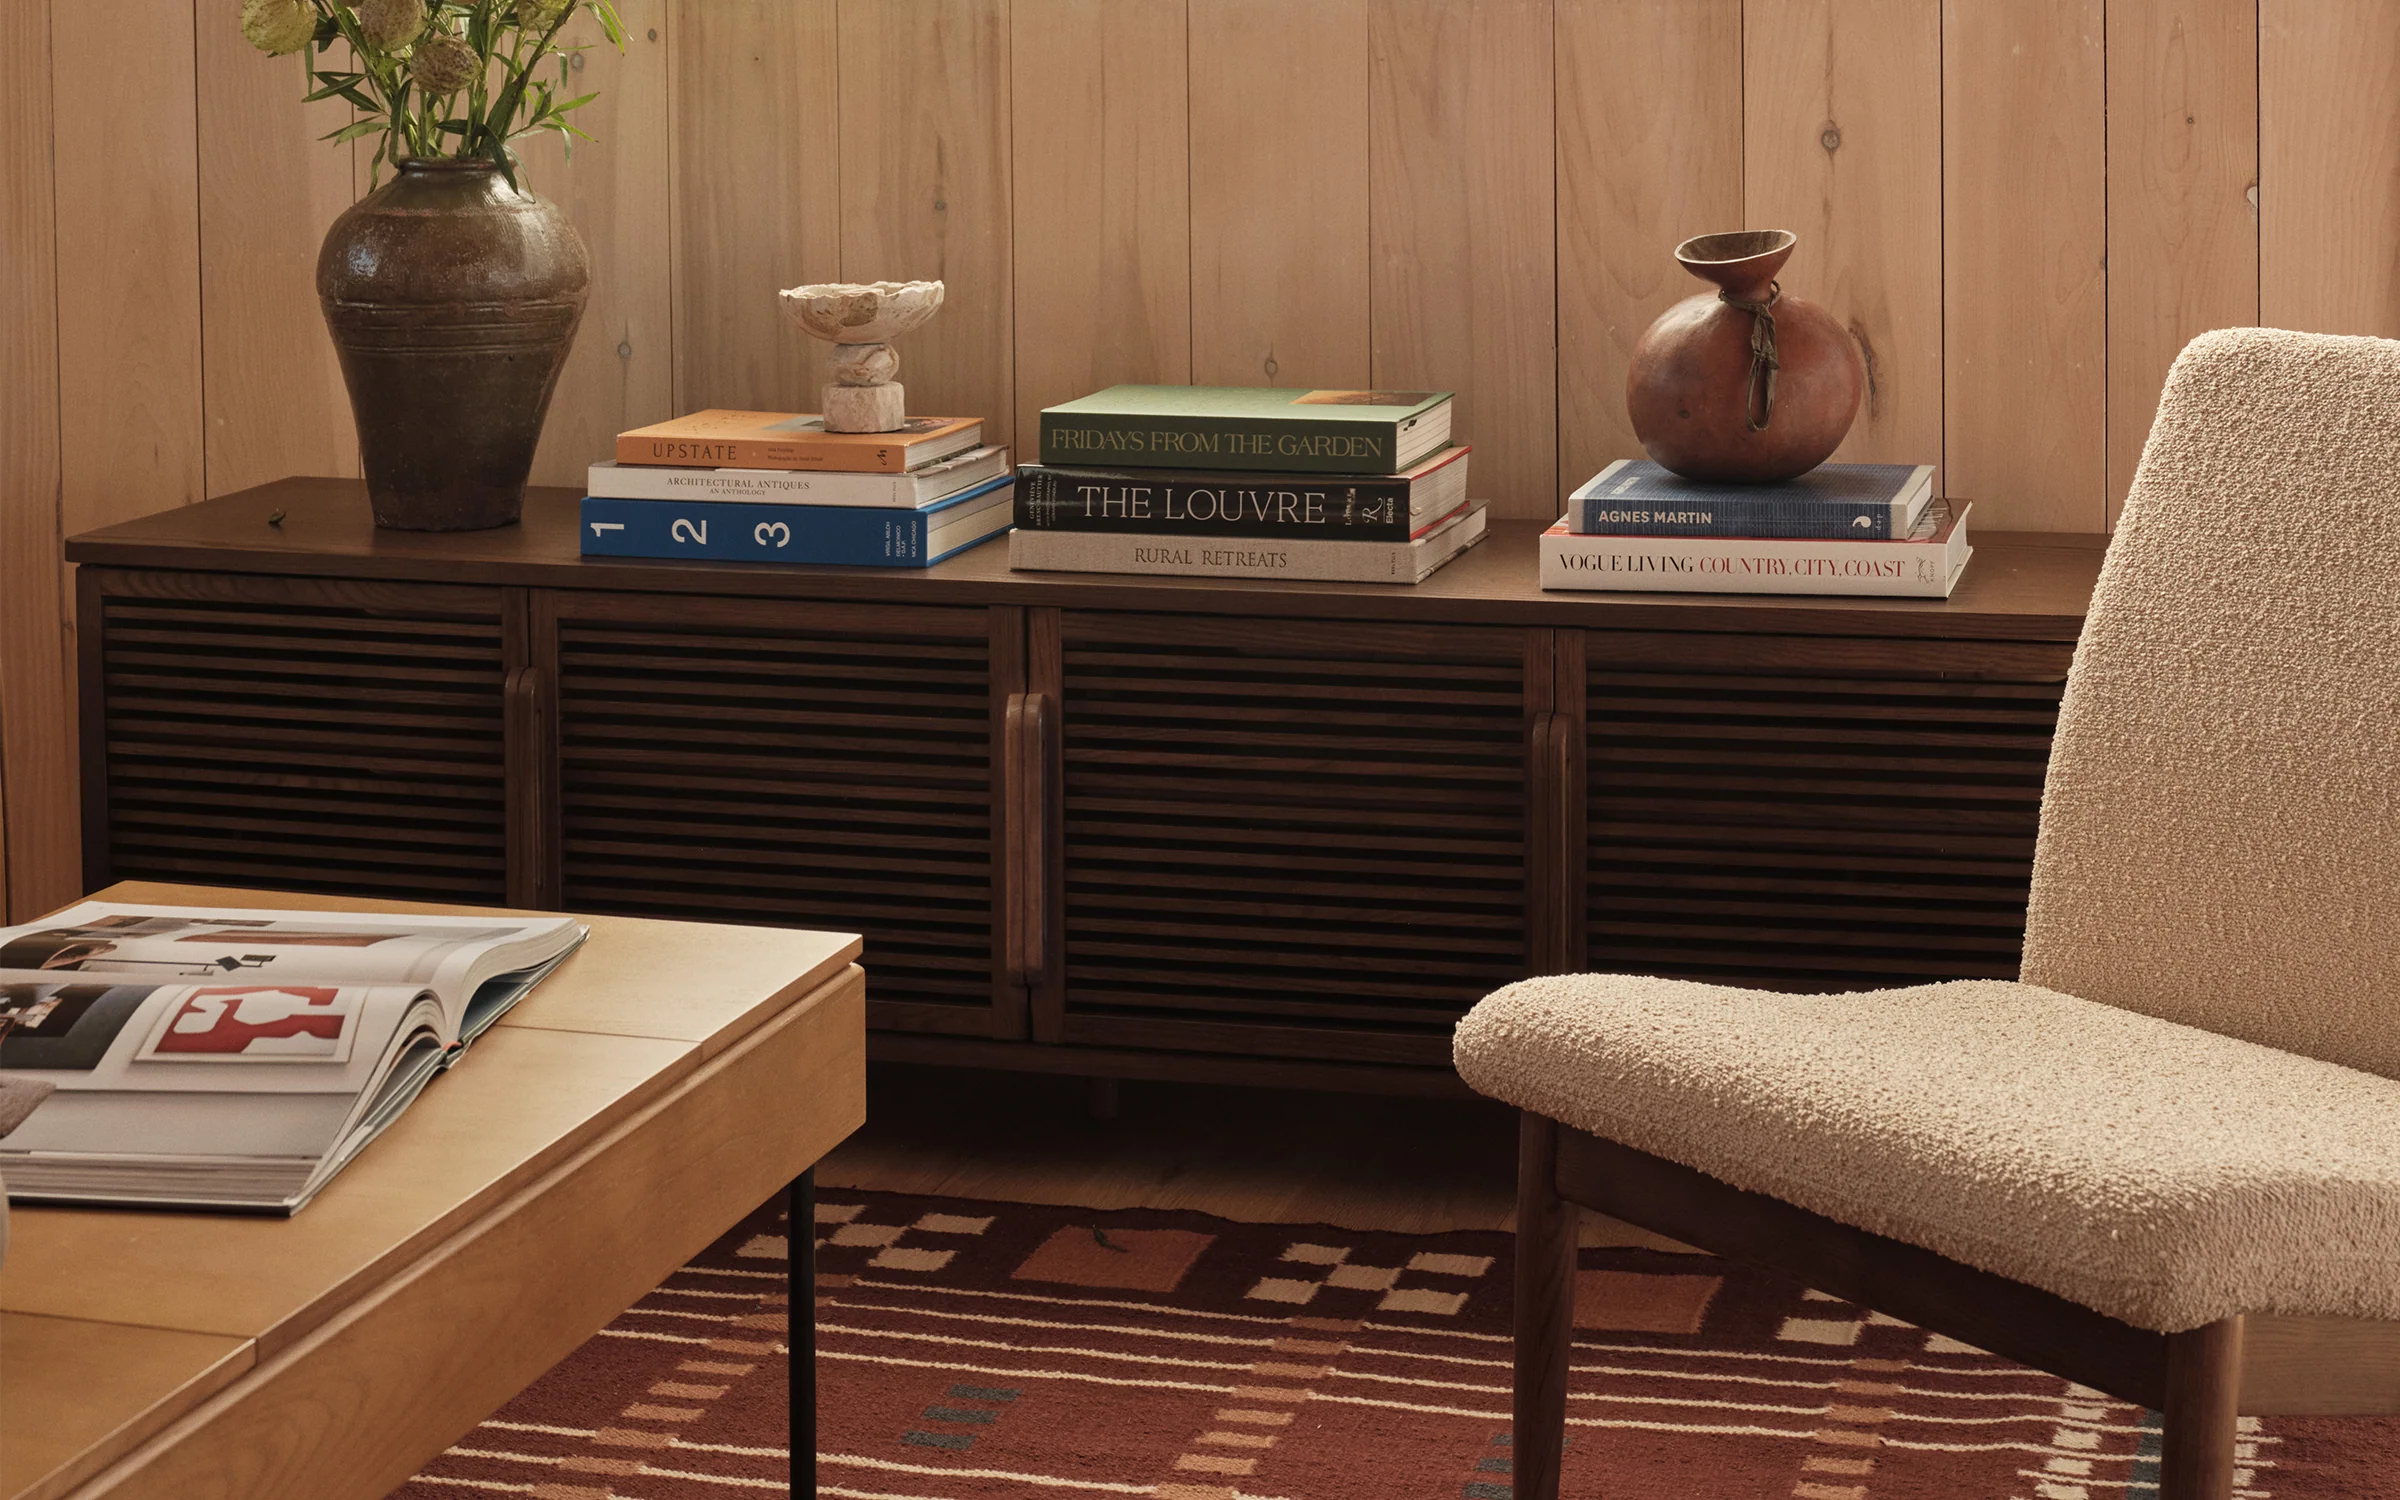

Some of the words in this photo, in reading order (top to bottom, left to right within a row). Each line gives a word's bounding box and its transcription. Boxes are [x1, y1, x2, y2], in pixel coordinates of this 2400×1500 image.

[653, 443, 737, 460] UPSTATE
[1052, 428, 1145, 450] FRIDAYS
[1151, 431, 1219, 453] FROM
[1224, 433, 1273, 455] THE
[1278, 434, 1383, 458] GARDEN
[666, 477, 753, 488] ARCHITECTURAL
[757, 479, 810, 490] ANTIQUES
[1077, 486, 1151, 519] THE
[1165, 488, 1326, 524] LOUVRE
[1386, 497, 1394, 524] Electa
[1599, 510, 1650, 523] AGNES
[1654, 511, 1712, 524] MARTIN
[590, 522, 625, 538] 1
[671, 518, 707, 545] 2
[754, 521, 791, 548] 3
[1135, 548, 1193, 565] RURAL
[1202, 550, 1287, 568] RETREATS
[1559, 554, 1623, 571] VOGUE
[1628, 555, 1694, 573] LIVING
[1844, 560, 1906, 577] COAST
